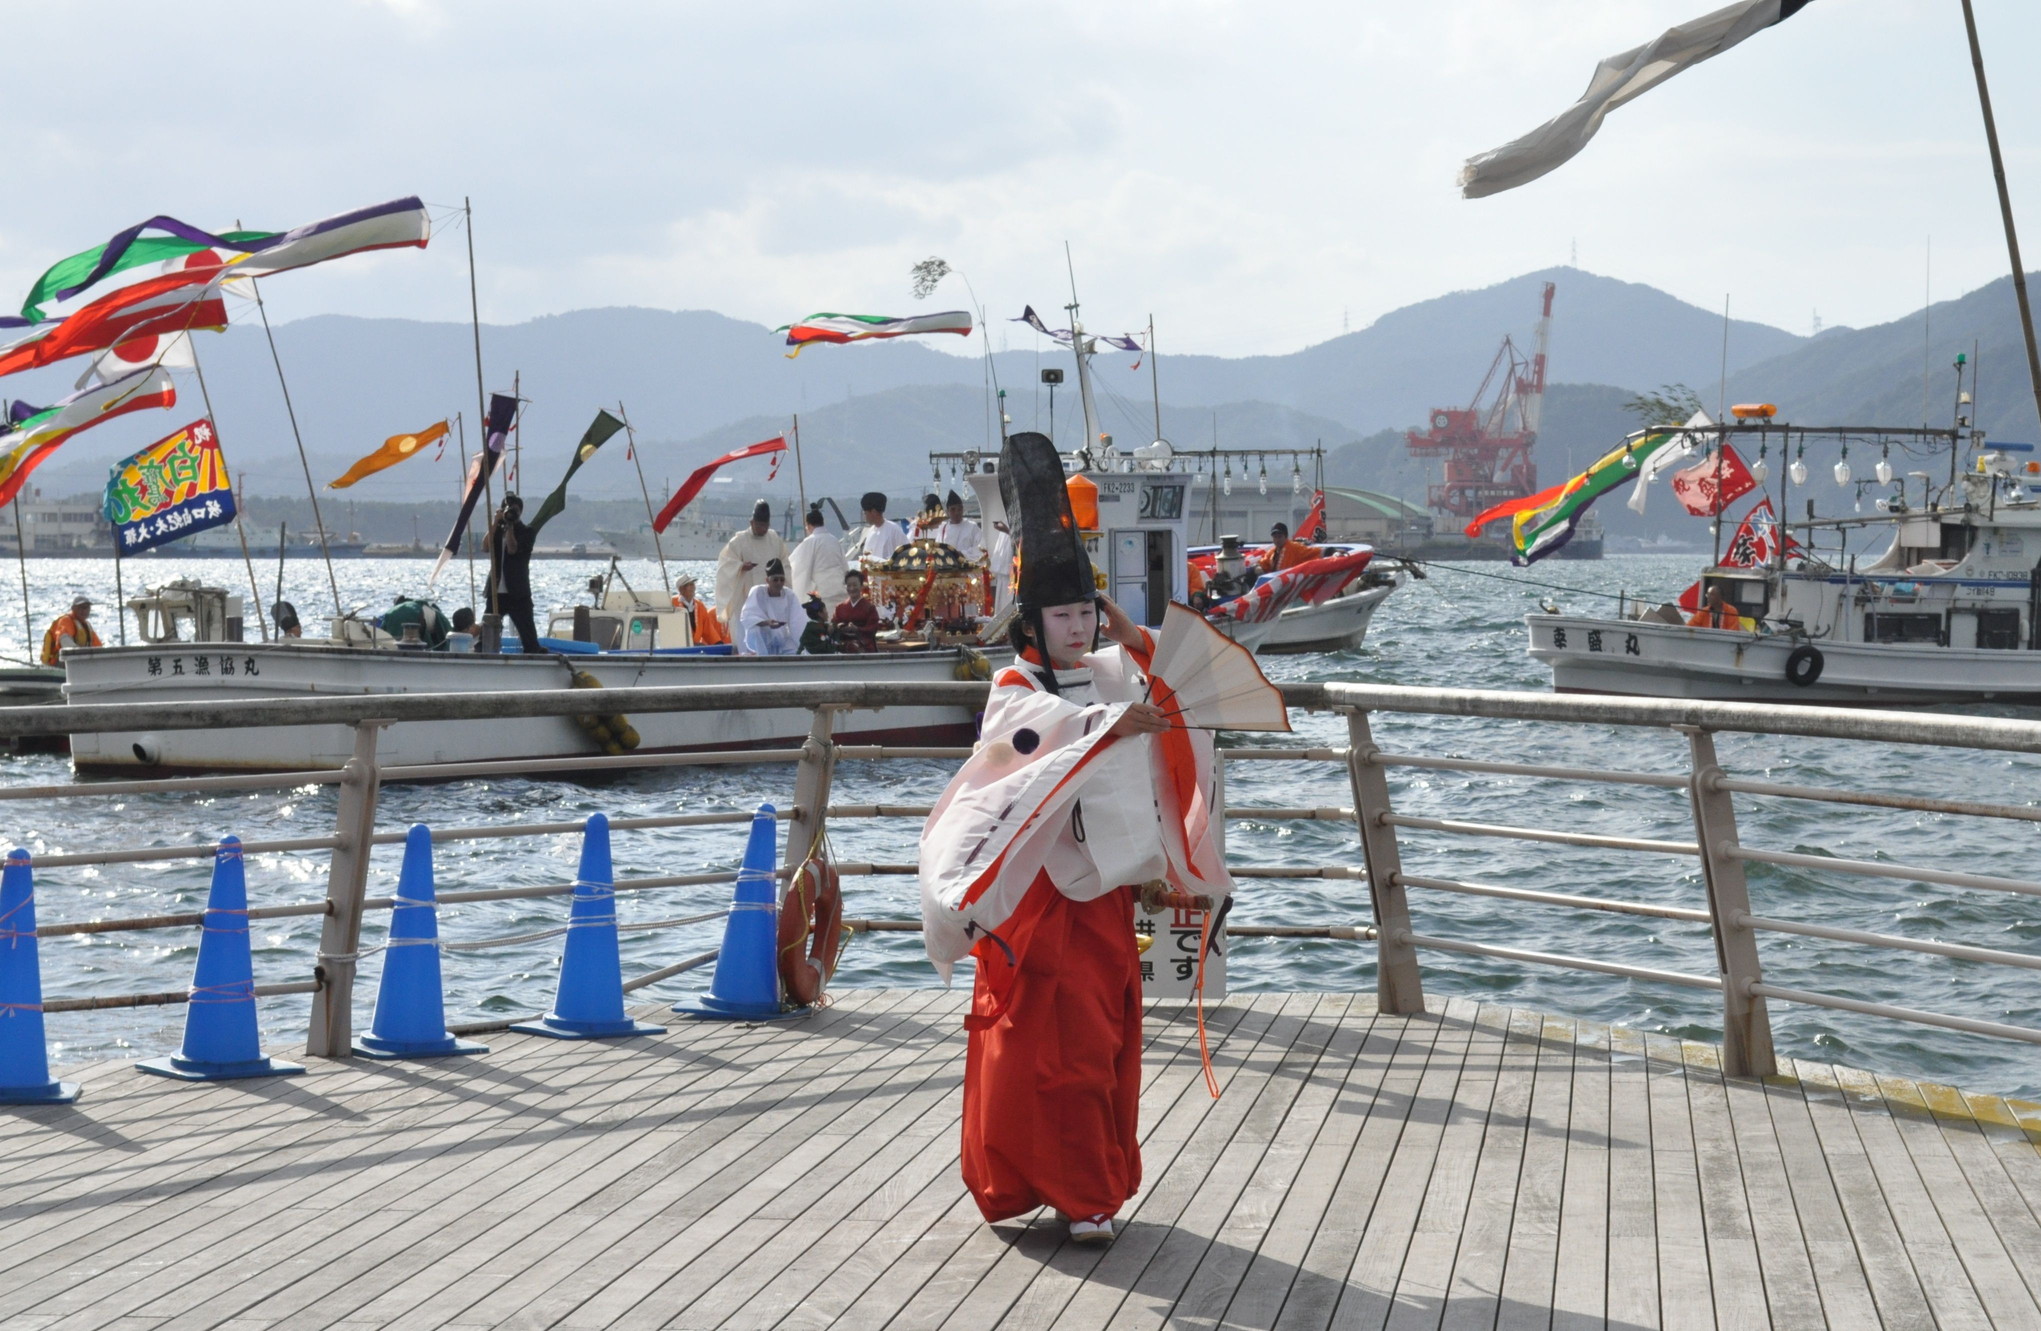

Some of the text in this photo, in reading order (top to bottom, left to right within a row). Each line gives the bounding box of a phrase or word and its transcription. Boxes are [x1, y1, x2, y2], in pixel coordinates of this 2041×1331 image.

[147, 655, 260, 677] 第五漁協丸
